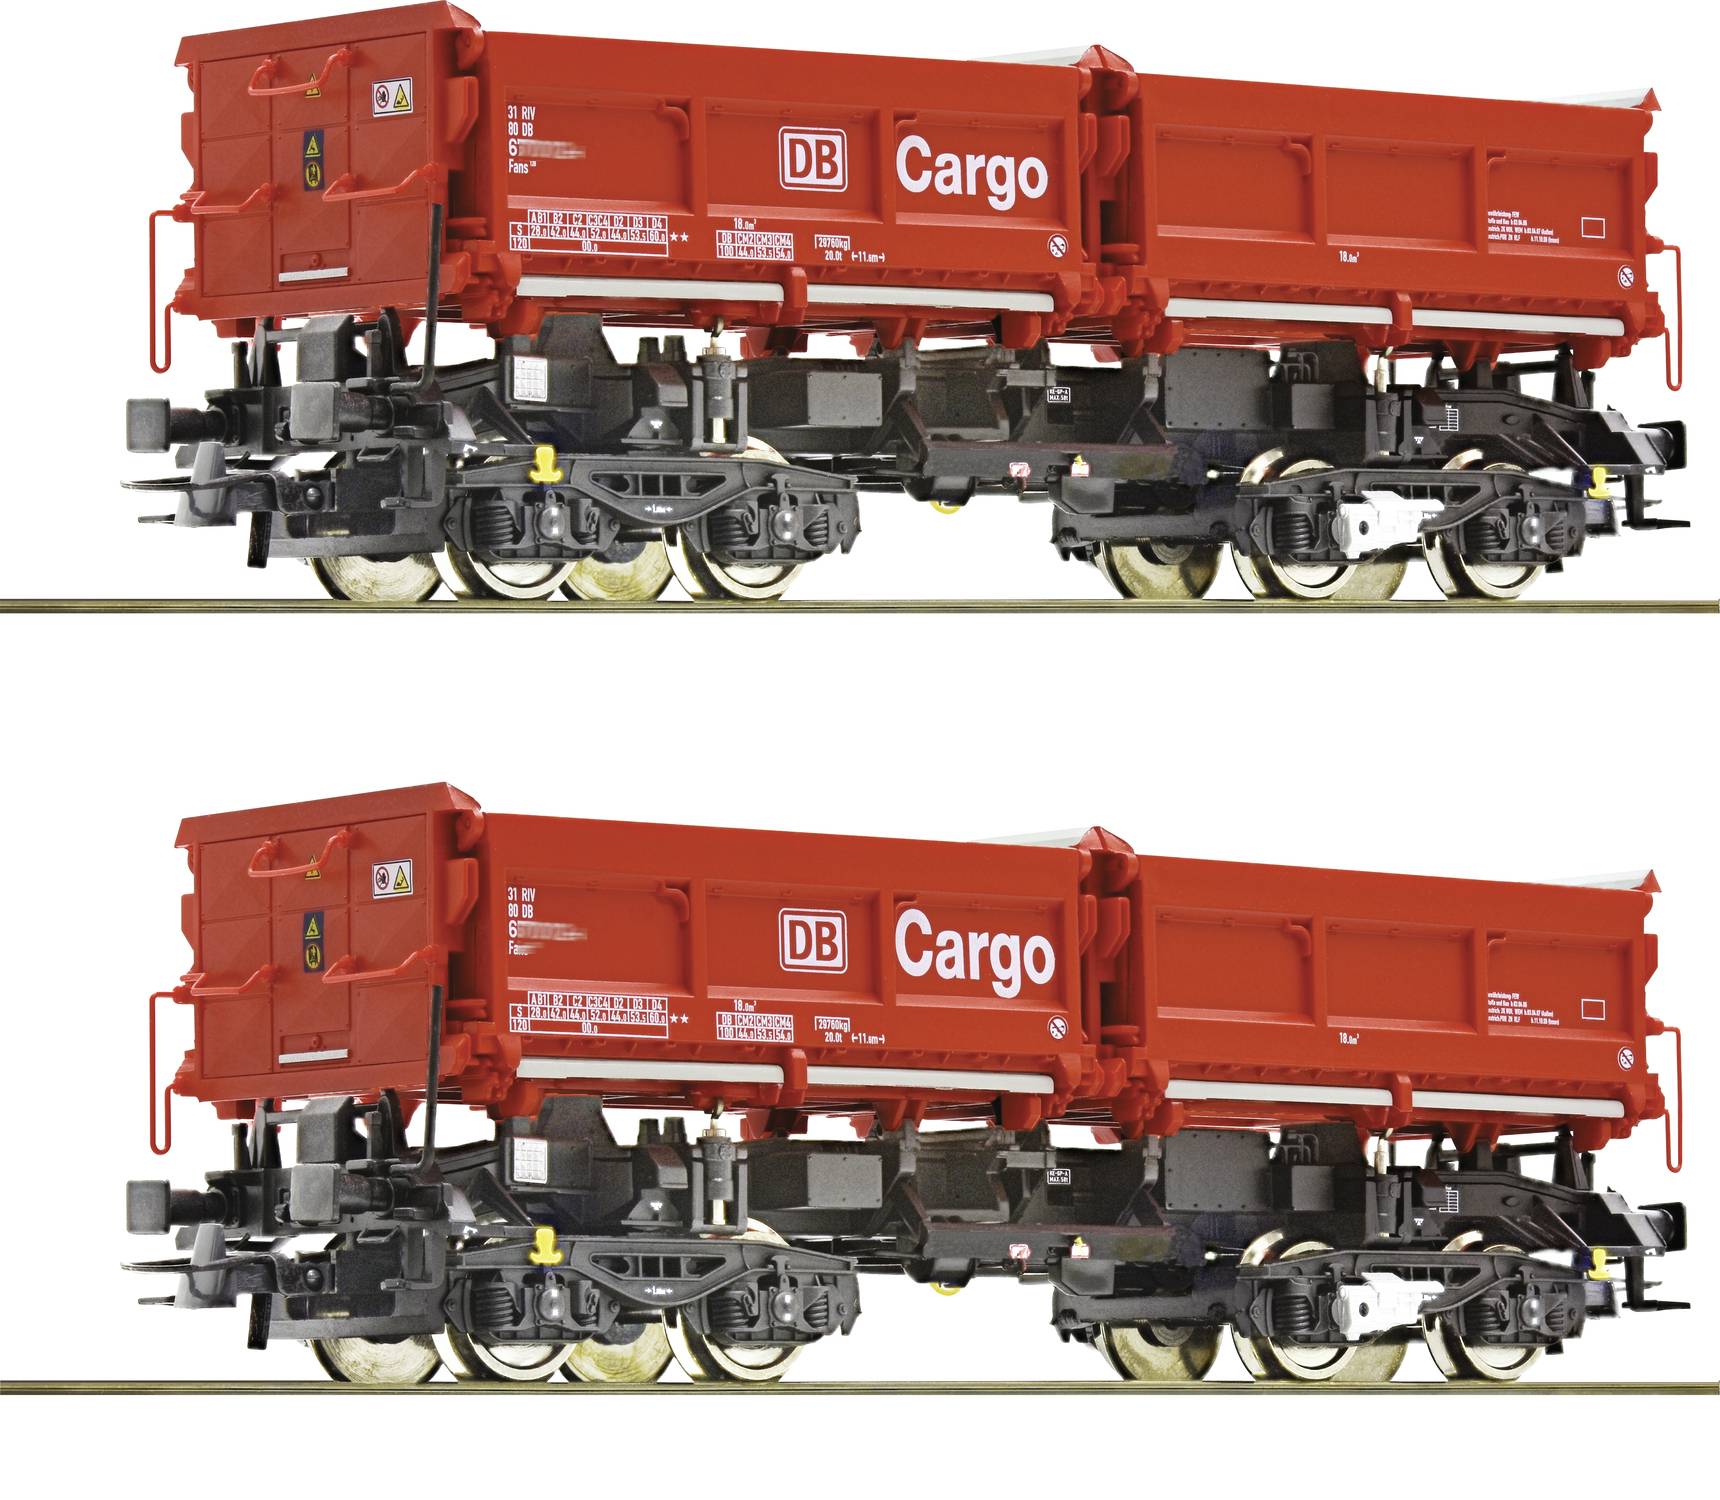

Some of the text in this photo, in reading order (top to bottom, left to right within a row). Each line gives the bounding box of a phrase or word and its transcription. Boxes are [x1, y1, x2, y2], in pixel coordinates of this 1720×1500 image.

[521, 106, 536, 120] RIV
[508, 121, 533, 137] 80 DB
[508, 159, 529, 174] Fans
[784, 133, 1049, 211] DB Cargo
[553, 213, 563, 225] B2
[572, 214, 583, 226] C2
[569, 226, 586, 239] 44.0
[590, 228, 607, 240] 52.0
[611, 228, 627, 241] 44.0
[630, 229, 646, 241] 53.5
[738, 232, 754, 245] CM2
[756, 233, 772, 246] CM3
[775, 234, 791, 246] CM4
[512, 237, 528, 249] 120
[720, 245, 734, 256] 100
[757, 246, 773, 258] 53.5
[521, 888, 536, 902] RIV
[508, 903, 533, 919] 80 DB
[784, 908, 1056, 999] DB Cargo
[553, 995, 563, 1007] B2
[572, 996, 583, 1008] C2
[569, 1008, 586, 1021] 44.0
[590, 1010, 607, 1022] 52.0
[611, 1010, 627, 1023] 44.0
[630, 1011, 646, 1023] 53.5
[738, 1014, 754, 1027] CM2
[756, 1015, 772, 1028] CM3
[775, 1016, 791, 1028] CM4
[512, 1019, 528, 1031] 120
[720, 1027, 734, 1038] 100
[757, 1028, 773, 1040] 53.5
